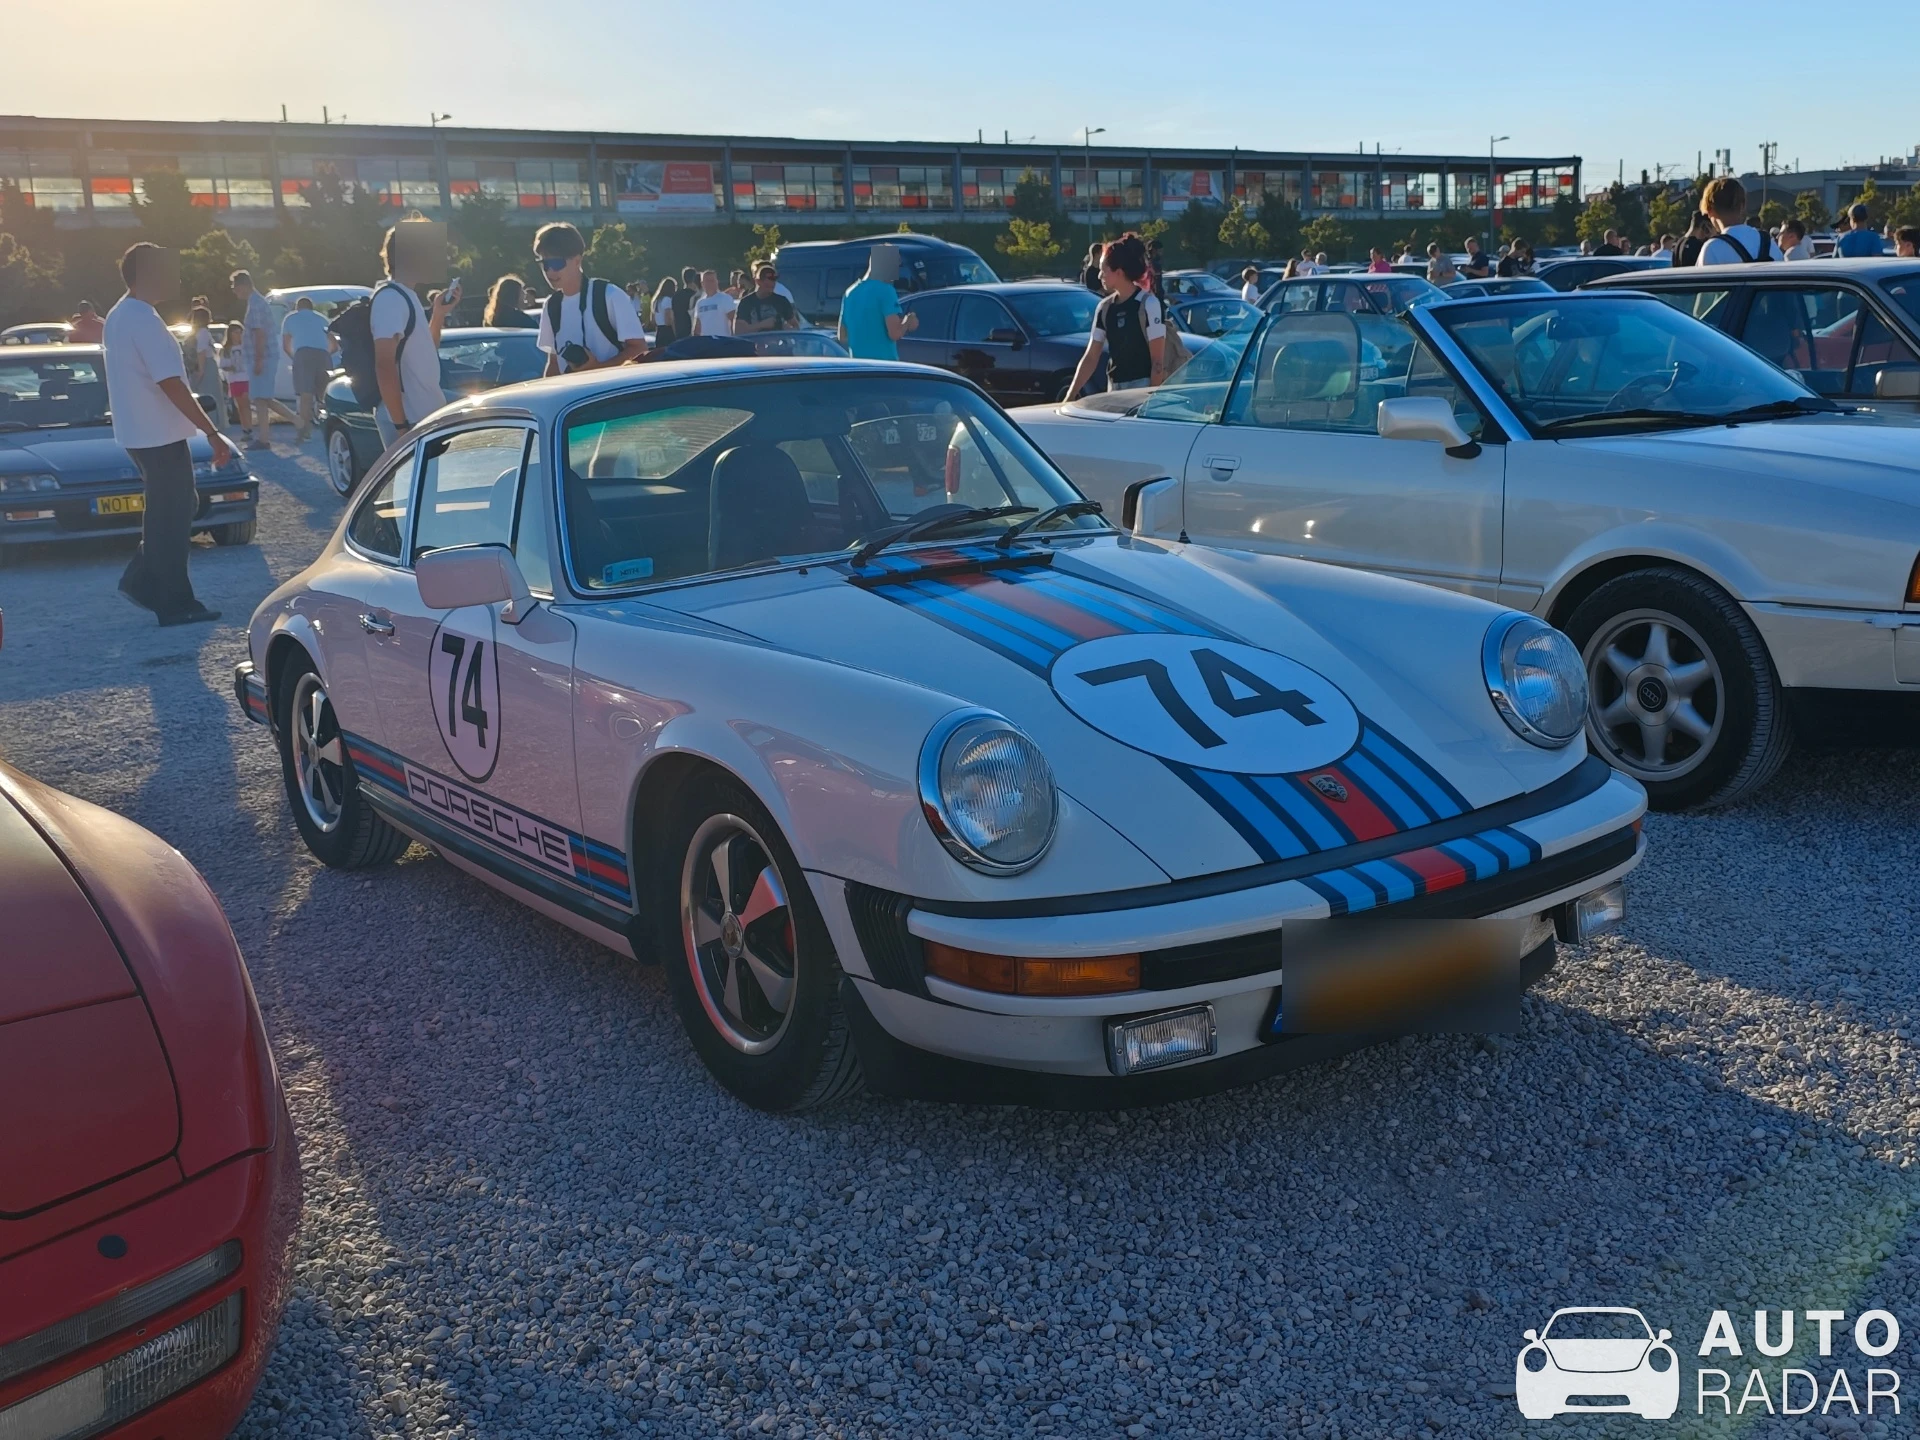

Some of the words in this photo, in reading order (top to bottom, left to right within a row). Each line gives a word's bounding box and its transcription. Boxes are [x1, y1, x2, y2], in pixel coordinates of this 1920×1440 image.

[441, 632, 489, 749] 74
[1073, 648, 1327, 749] 74
[407, 769, 570, 868] PORSCHE
